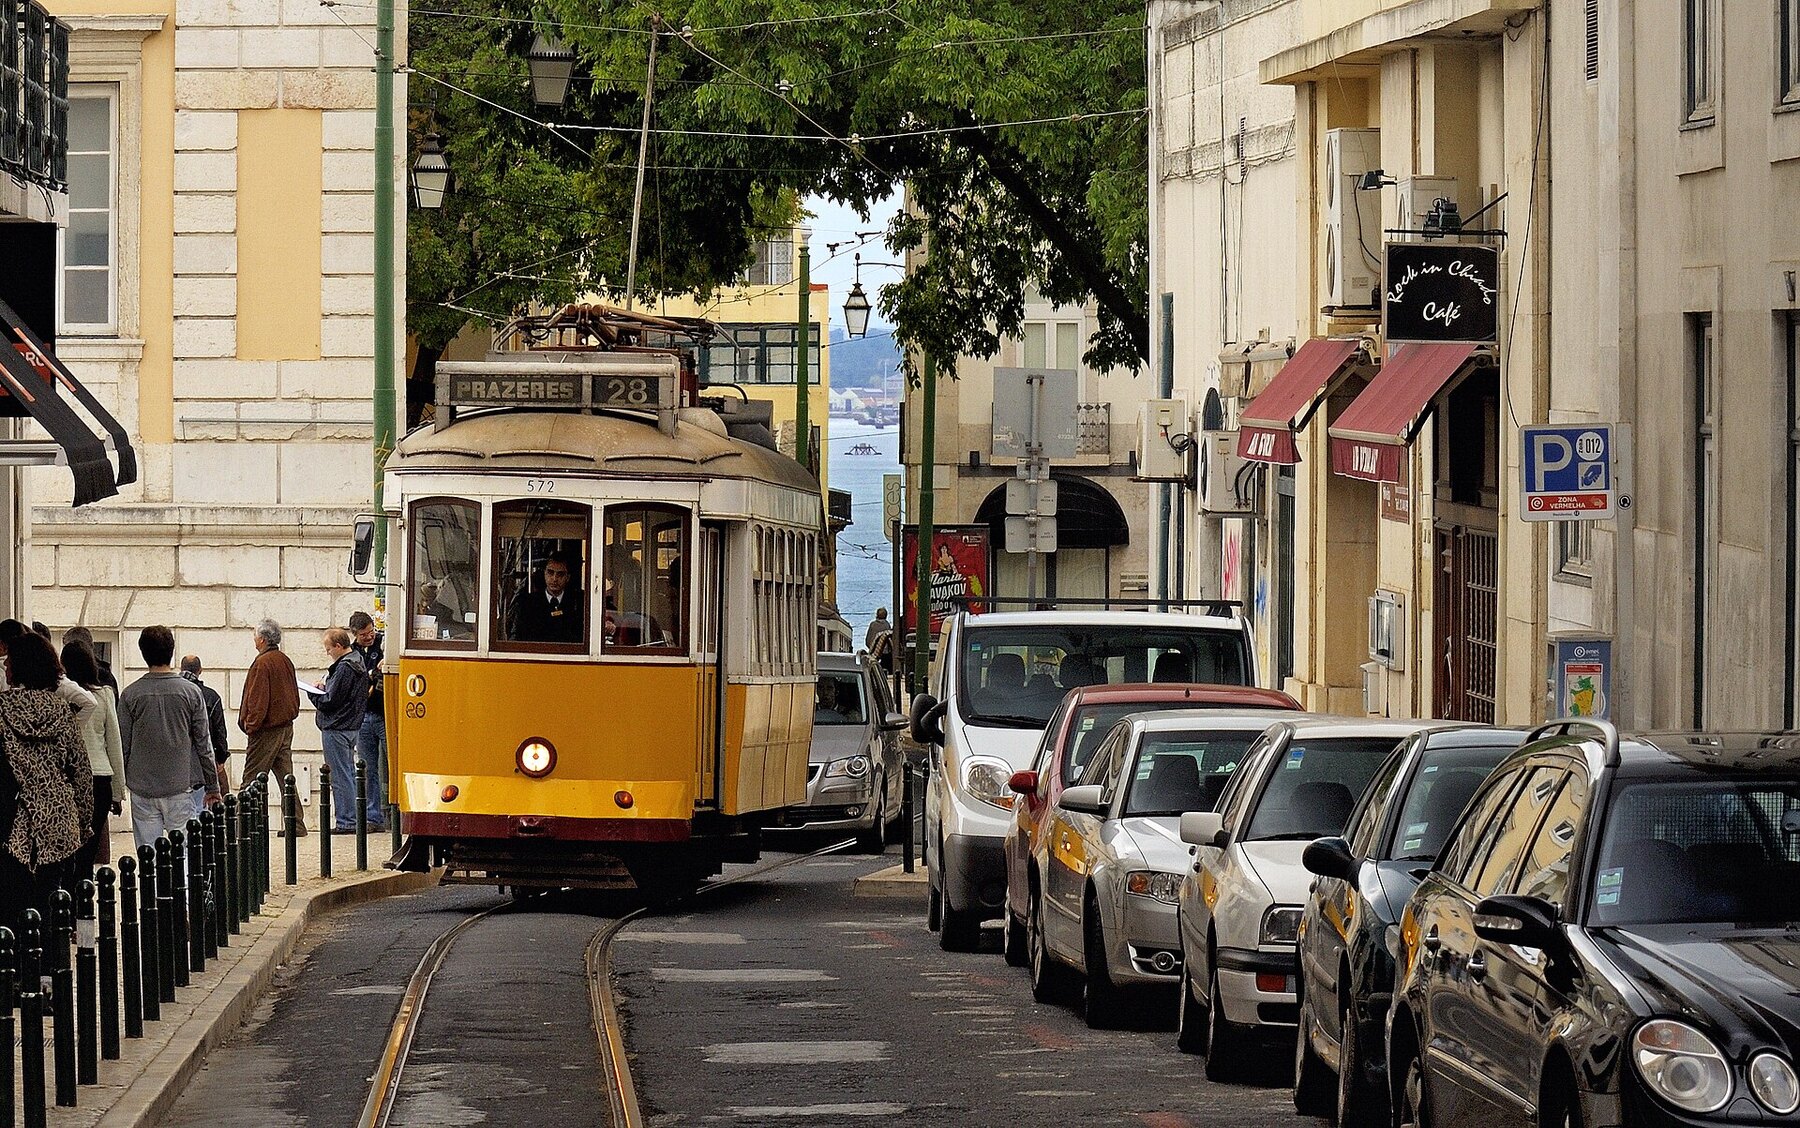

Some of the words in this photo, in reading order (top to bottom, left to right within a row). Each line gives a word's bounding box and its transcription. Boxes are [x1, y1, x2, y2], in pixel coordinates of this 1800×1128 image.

[1386, 265, 1418, 303] Rock
[1421, 262, 1442, 274] in
[1448, 261, 1496, 305] Chiado
[1423, 301, 1461, 327] Café
[456, 381, 574, 399] PRAZERES
[607, 378, 648, 404] 28
[1585, 438, 1601, 454] 012
[1534, 434, 1573, 491] P
[527, 480, 555, 493] 572
